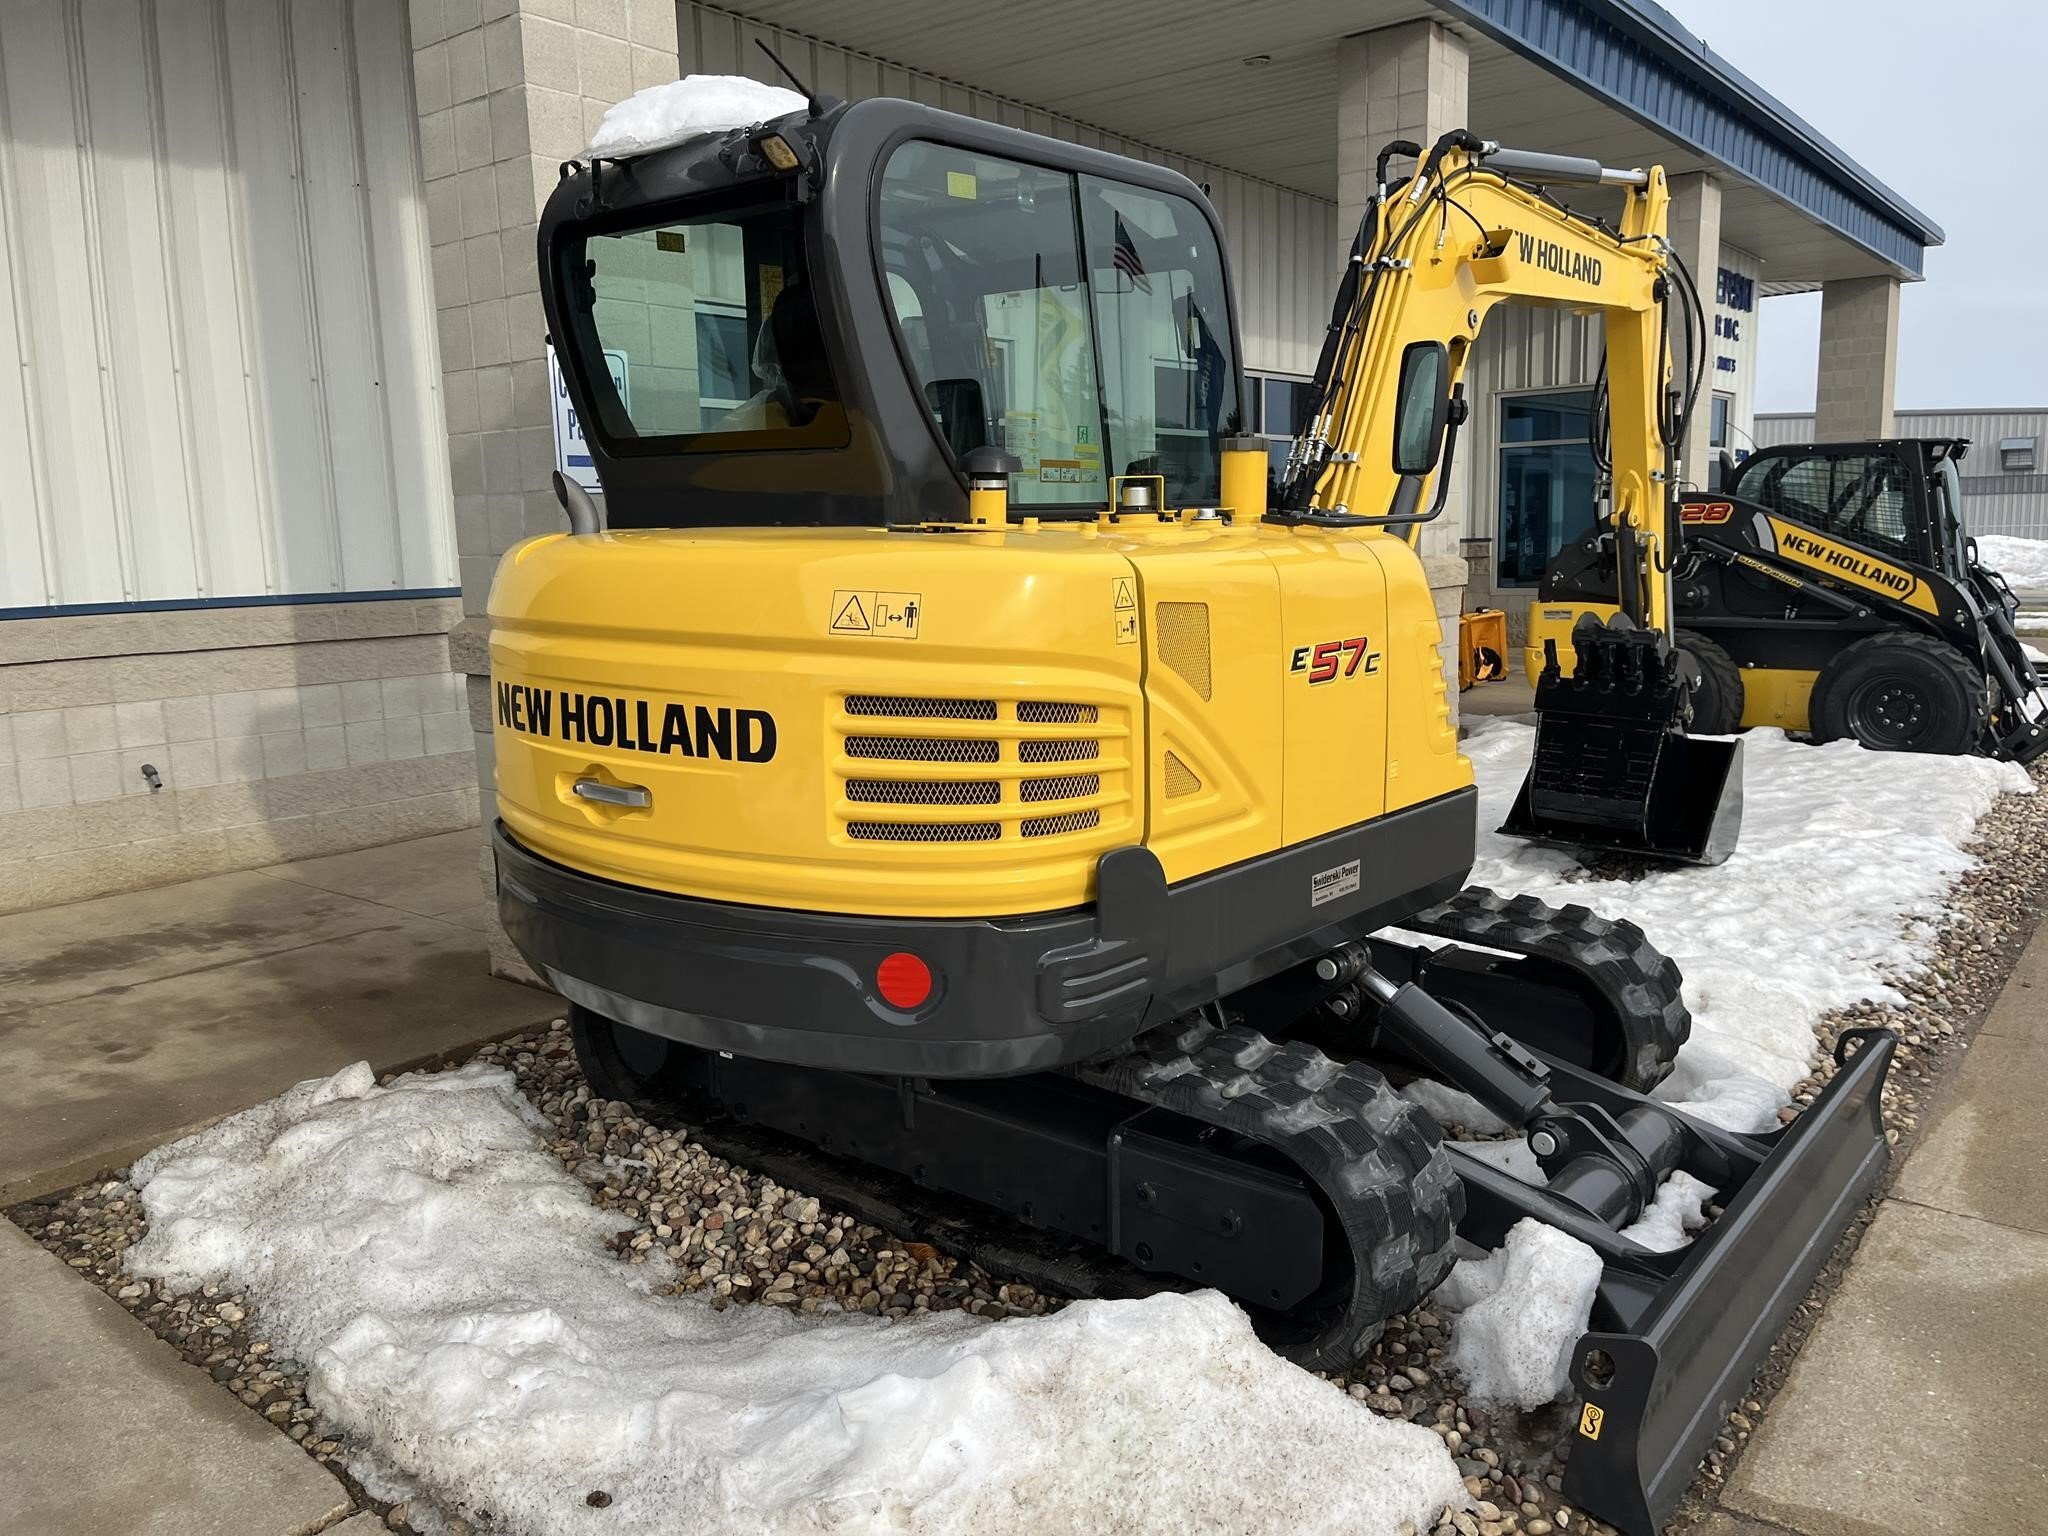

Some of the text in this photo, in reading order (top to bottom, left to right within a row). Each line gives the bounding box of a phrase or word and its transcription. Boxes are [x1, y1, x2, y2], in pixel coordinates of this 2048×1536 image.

[1537, 239, 1602, 286] HOLLAND
[1680, 503, 1732, 523] 28
[1783, 533, 1910, 592] NEW HOLLAND
[497, 681, 777, 763] NEW HOLLAND
[1313, 869, 1341, 888] Swiderski
[1341, 865, 1359, 877] Power
